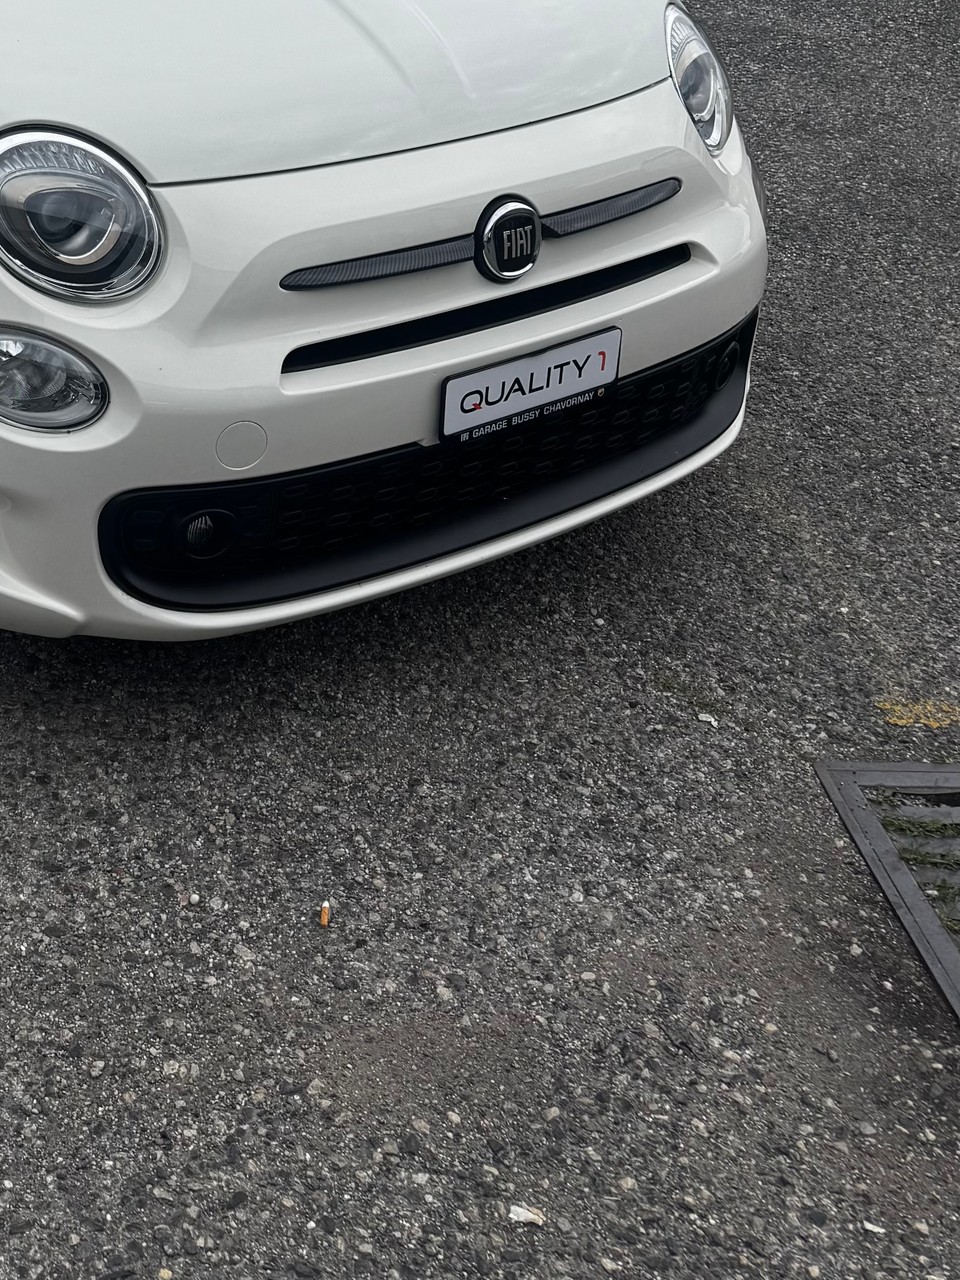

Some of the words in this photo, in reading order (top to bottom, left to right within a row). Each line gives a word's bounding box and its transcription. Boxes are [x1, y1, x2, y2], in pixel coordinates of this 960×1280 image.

[502, 224, 533, 260] FIAT
[459, 354, 592, 414] QUALITY
[597, 350, 607, 371] 1
[472, 419, 508, 438] GARAGE
[511, 408, 540, 426] BUSSY
[543, 391, 595, 415] CHAVORNAY
